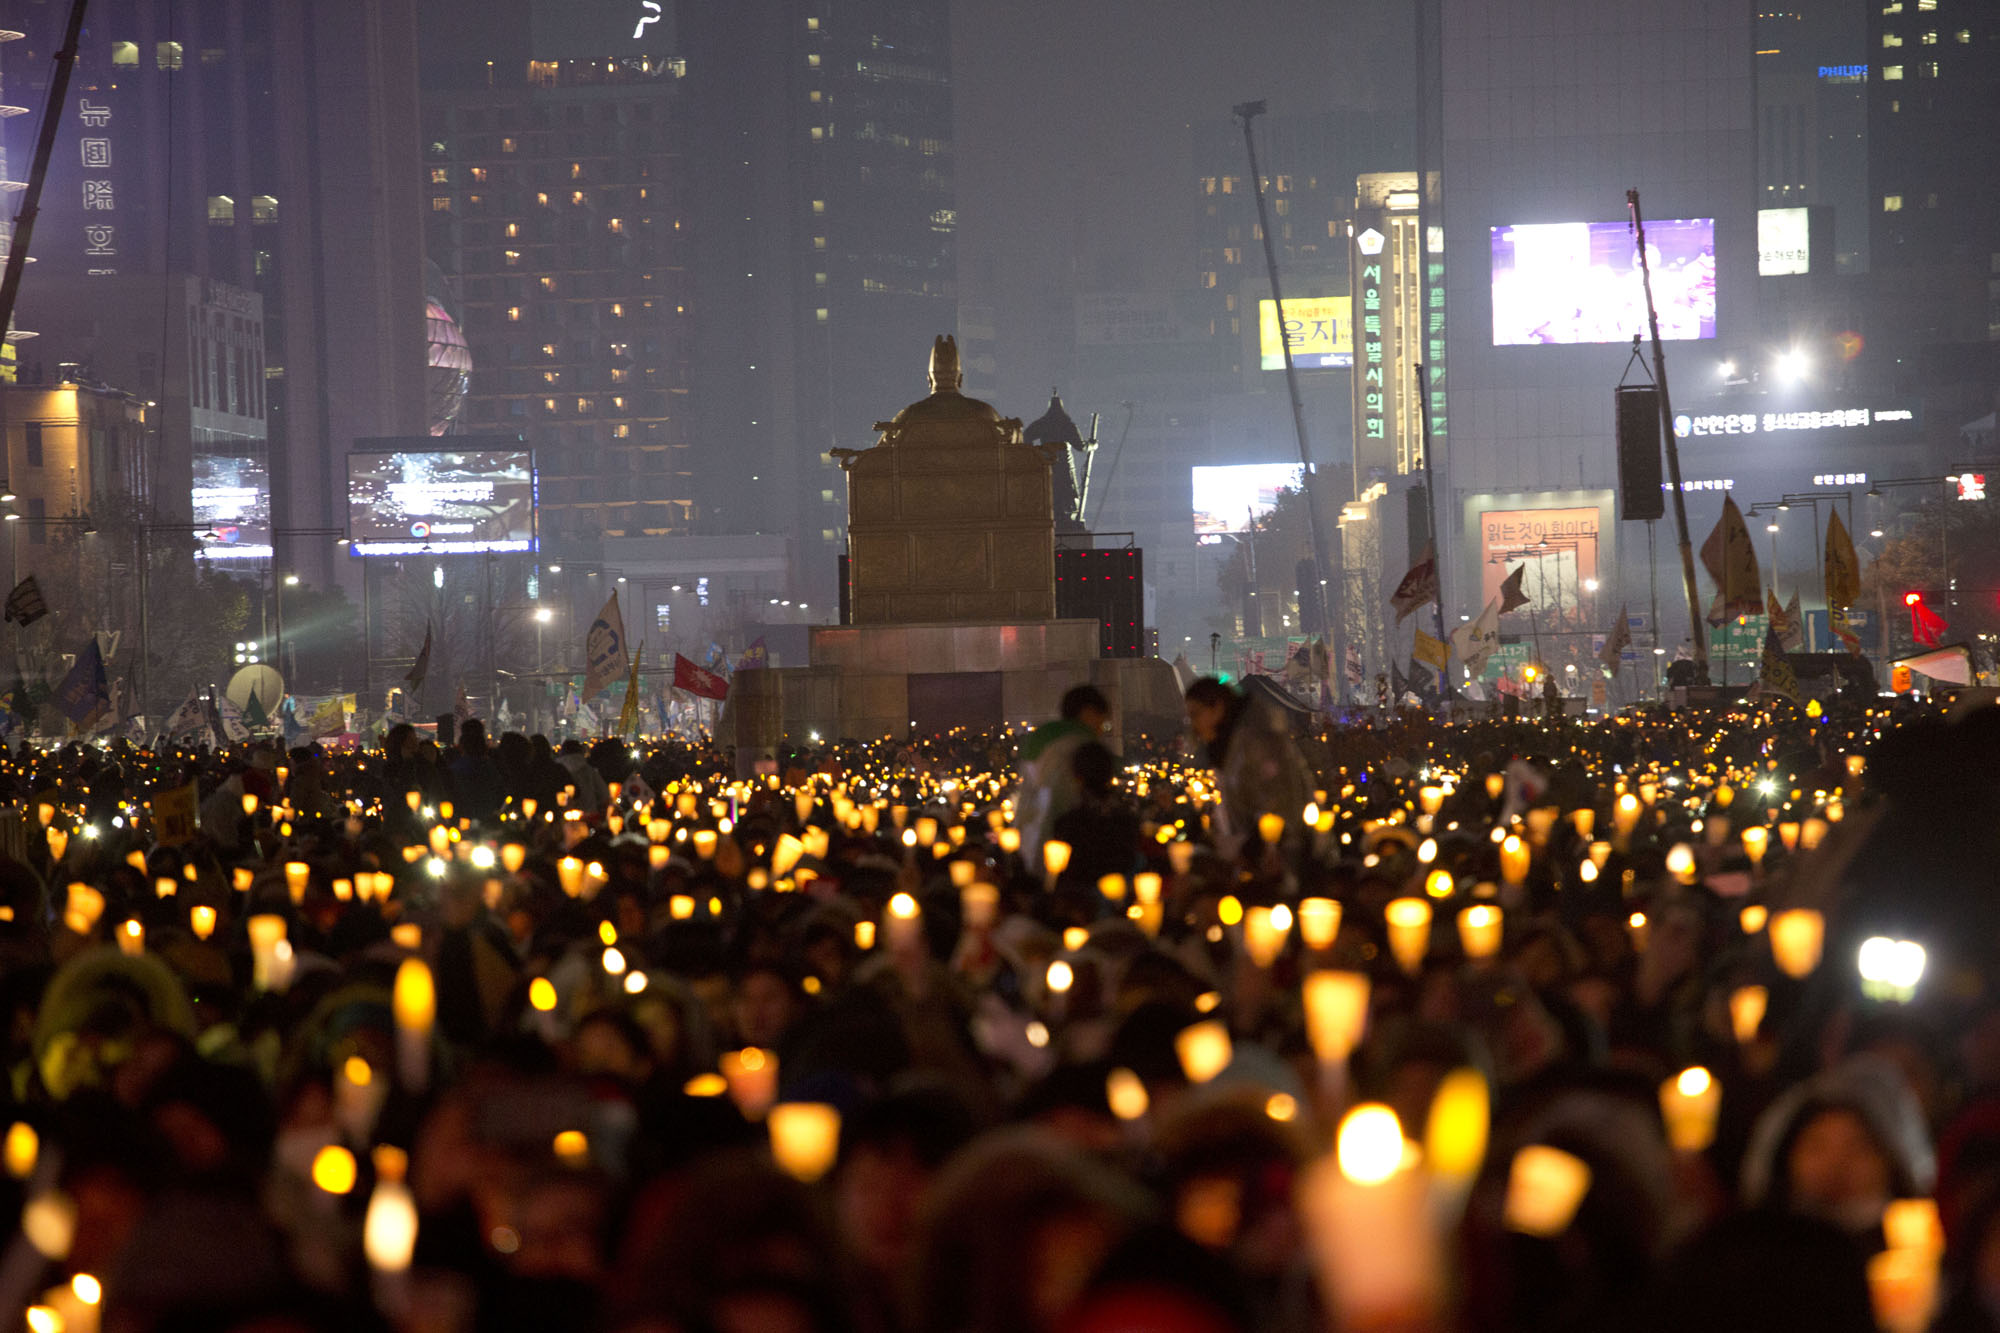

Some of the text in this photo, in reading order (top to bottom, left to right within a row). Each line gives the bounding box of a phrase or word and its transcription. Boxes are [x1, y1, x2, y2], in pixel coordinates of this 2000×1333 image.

[80, 99, 116, 275] 뉴國際호
[1758, 249, 1806, 261] 손해보험
[1363, 265, 1384, 438] 서울특별시의회
[1693, 414, 1756, 435] 신한은행
